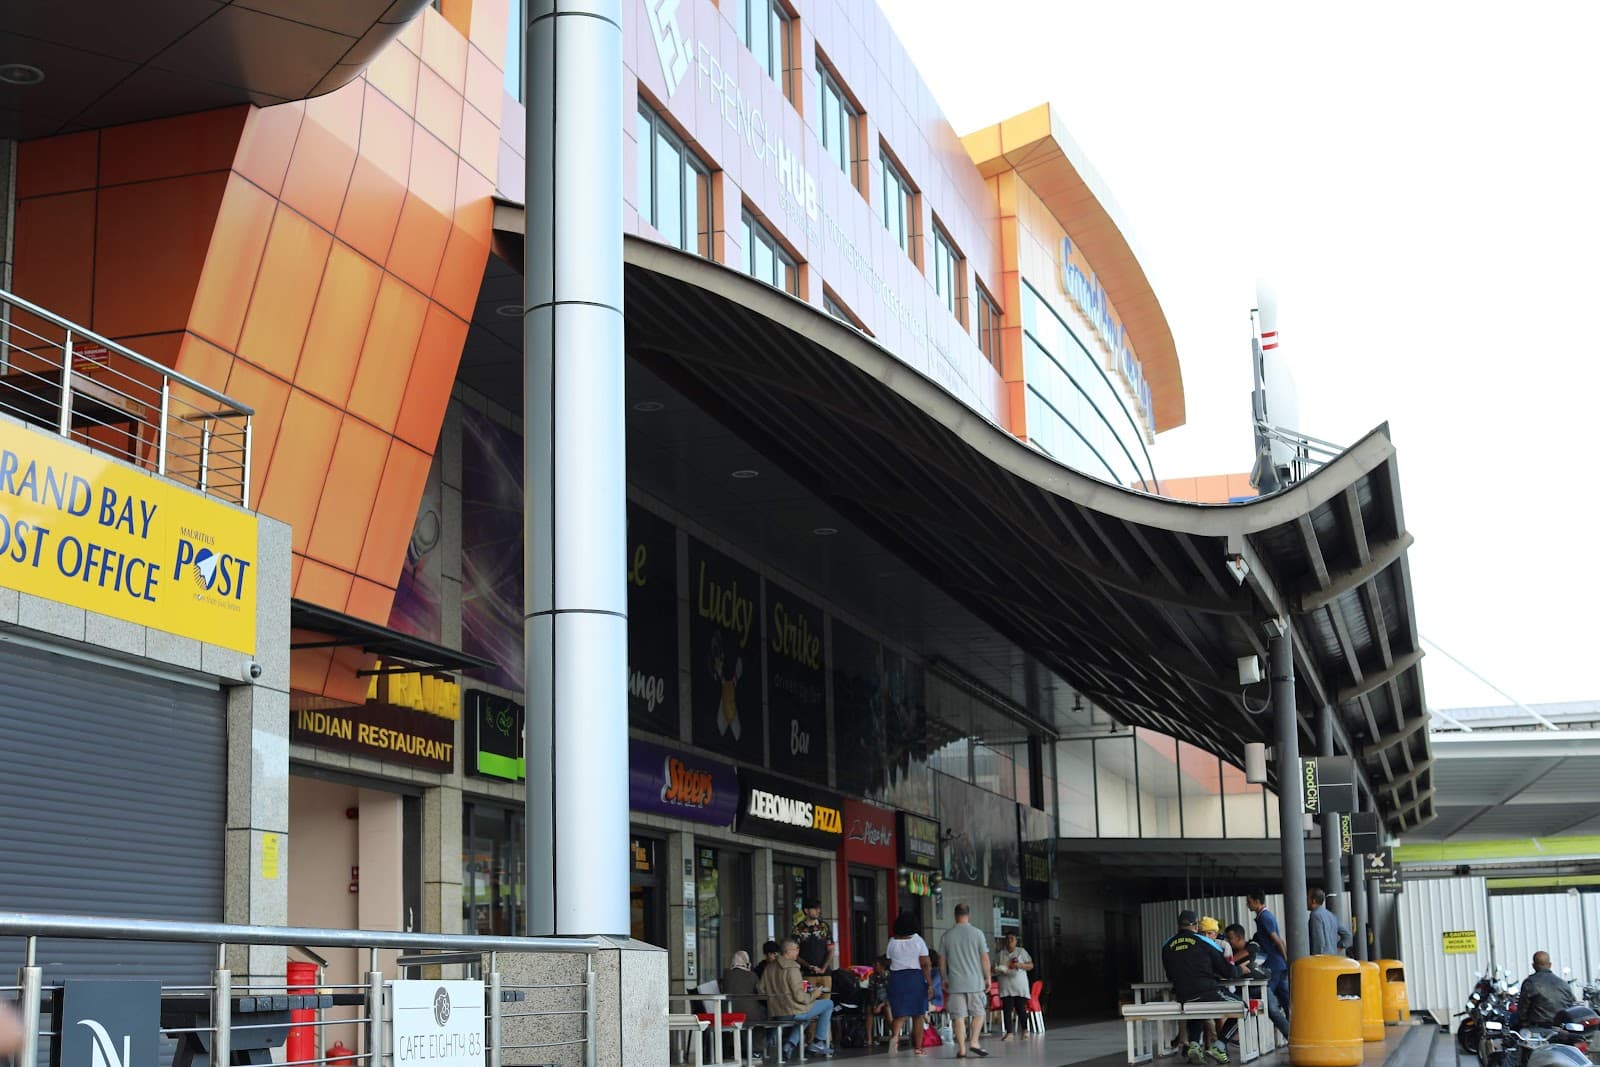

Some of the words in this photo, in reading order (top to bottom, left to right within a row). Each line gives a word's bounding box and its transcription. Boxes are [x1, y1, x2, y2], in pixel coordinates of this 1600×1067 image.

[0, 451, 92, 517] RAND
[98, 486, 158, 540] BAY
[57, 535, 160, 602] OFFICE
[173, 538, 251, 601] POST
[698, 560, 753, 648] Lucky
[772, 602, 820, 671] Strike
[298, 710, 353, 741] INDIAN
[357, 723, 453, 763] RESTAURANT
[790, 718, 810, 756] Bar
[661, 756, 713, 807] Steers
[1305, 760, 1318, 811] FoodCity
[750, 789, 814, 829] DEBONAIRS
[814, 805, 843, 834] PIZZA
[1341, 815, 1351, 853] FoodCity
[399, 1035, 426, 1061] CAFE
[429, 1033, 466, 1058] EIGHTY
[469, 1032, 481, 1056] 83
